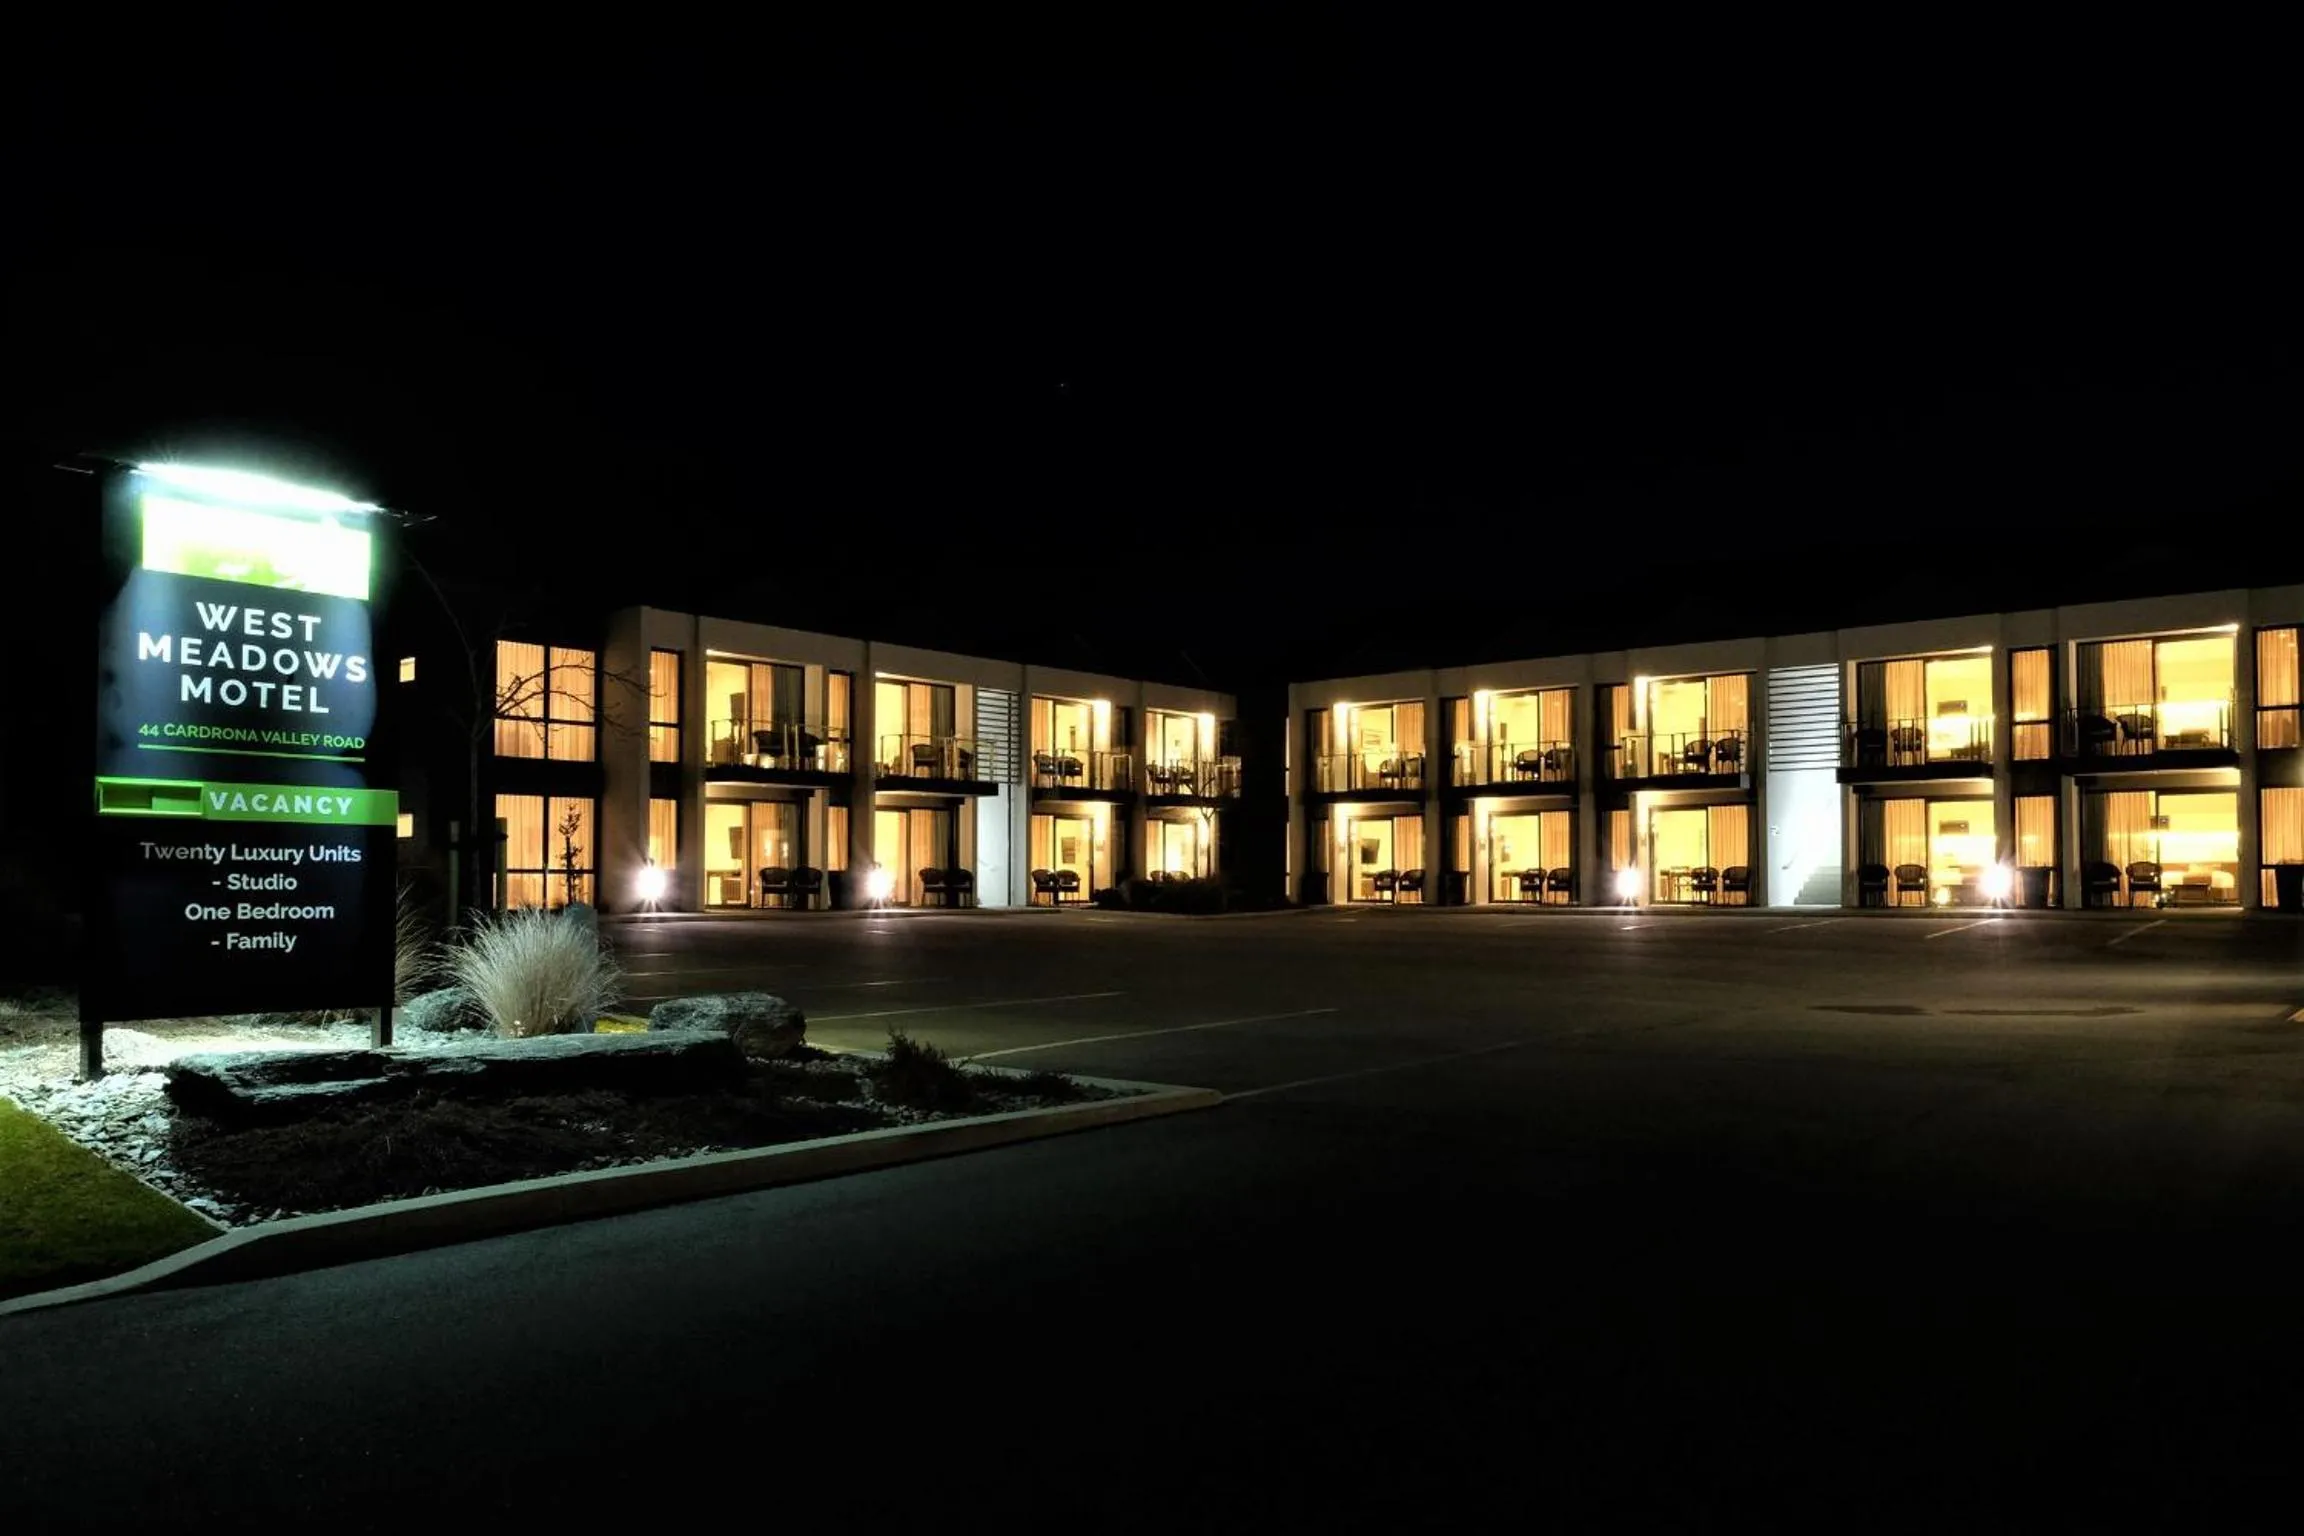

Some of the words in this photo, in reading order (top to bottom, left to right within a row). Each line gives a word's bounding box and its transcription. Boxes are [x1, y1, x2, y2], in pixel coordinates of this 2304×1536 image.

[196, 602, 321, 642] WEST
[138, 632, 368, 683] MEADOWS
[180, 674, 329, 713] MOTEL
[139, 723, 160, 737] 44
[164, 723, 258, 742] CARDRONA
[261, 730, 320, 747] VALLEY
[323, 734, 365, 749] ROAD
[209, 791, 353, 816] VACANCY
[139, 842, 225, 865] Twenty
[231, 843, 304, 865] Luxury
[309, 845, 362, 862] Units
[227, 873, 297, 890] Studio
[185, 903, 231, 920] One
[237, 903, 334, 920] Bedroom
[226, 932, 297, 952] Family
